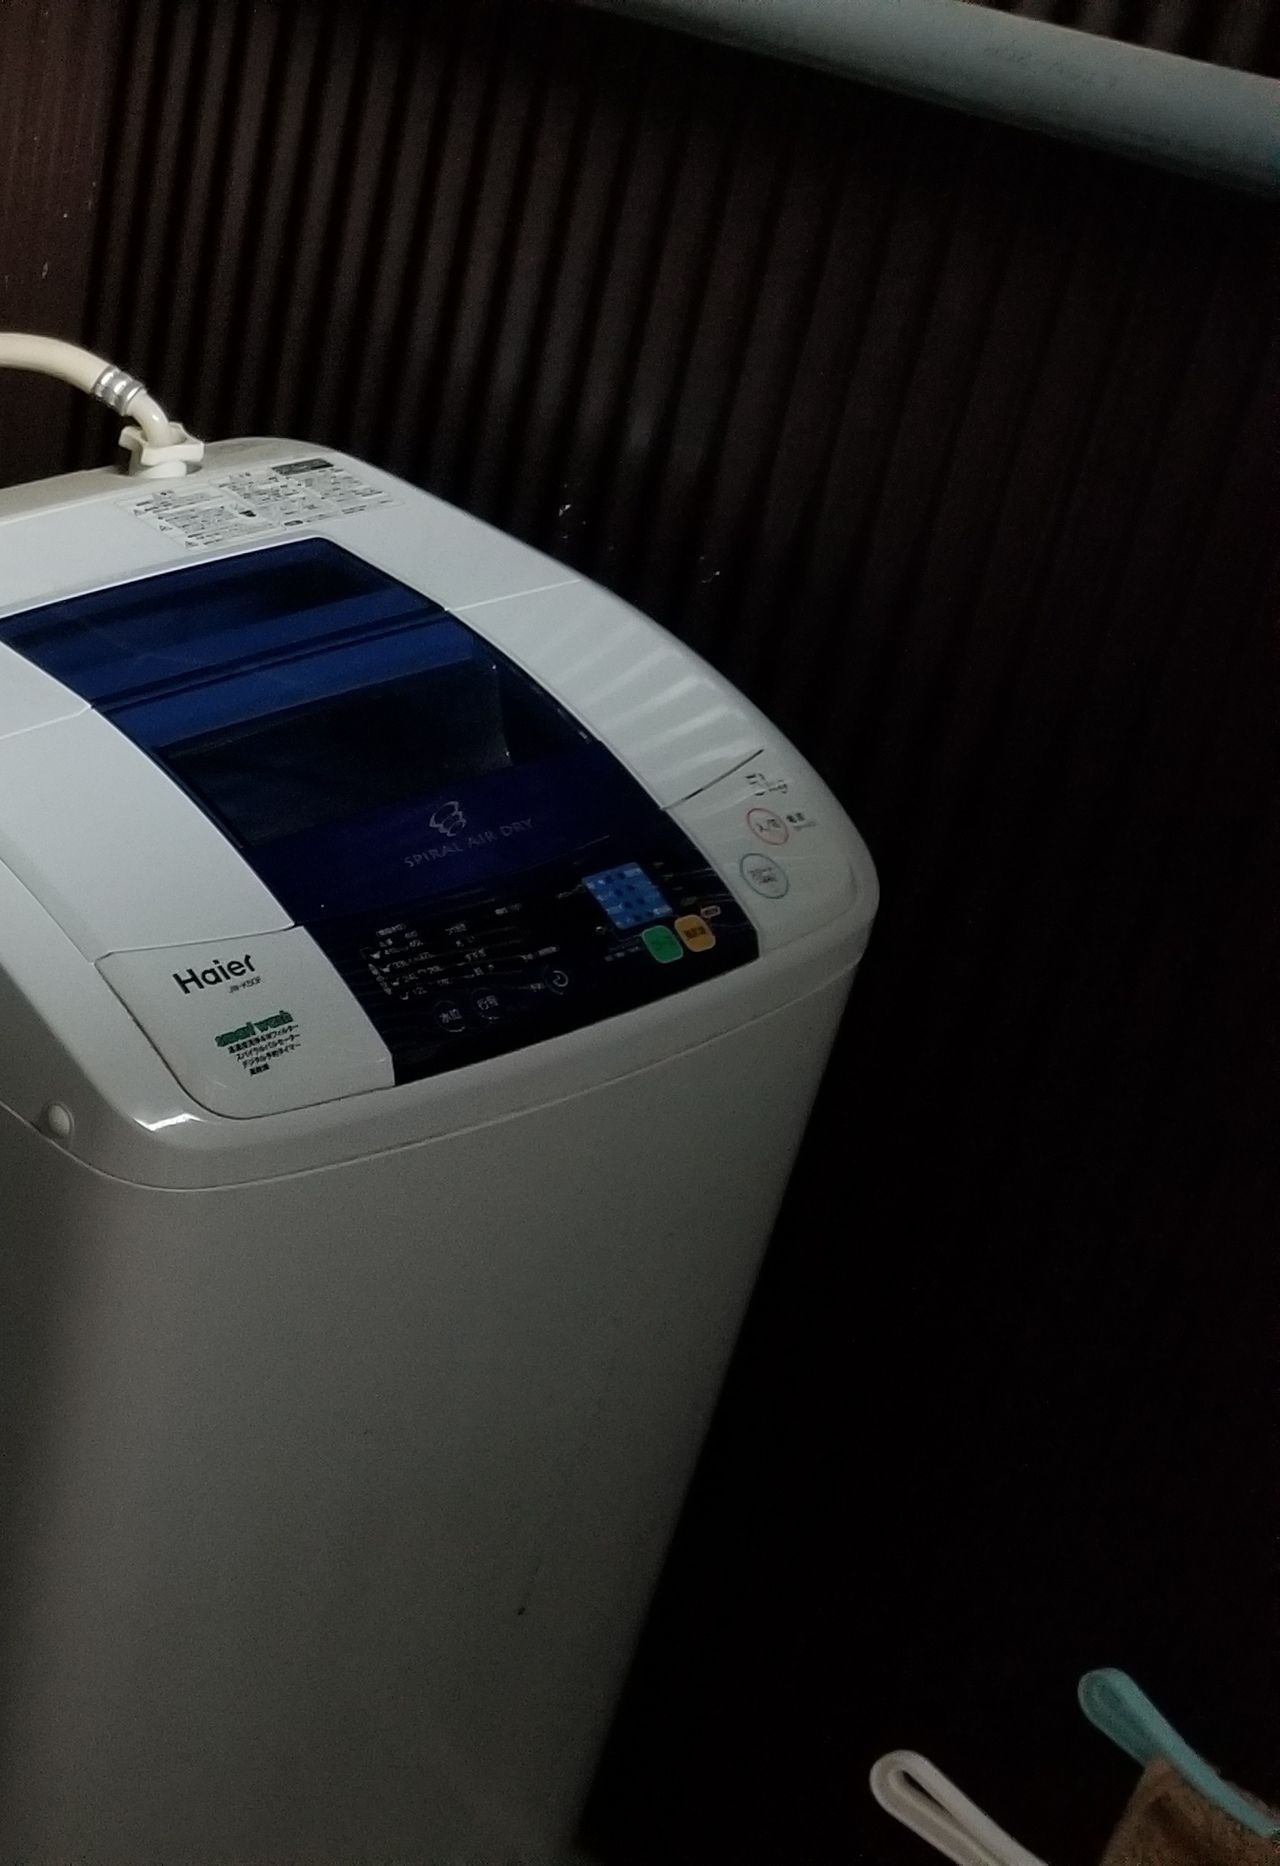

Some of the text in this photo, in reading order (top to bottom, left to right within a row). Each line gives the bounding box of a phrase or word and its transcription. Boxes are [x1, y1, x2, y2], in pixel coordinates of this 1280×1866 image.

[403, 818, 533, 868] SPIRAL AIR DRY
[172, 954, 255, 994] Haier
